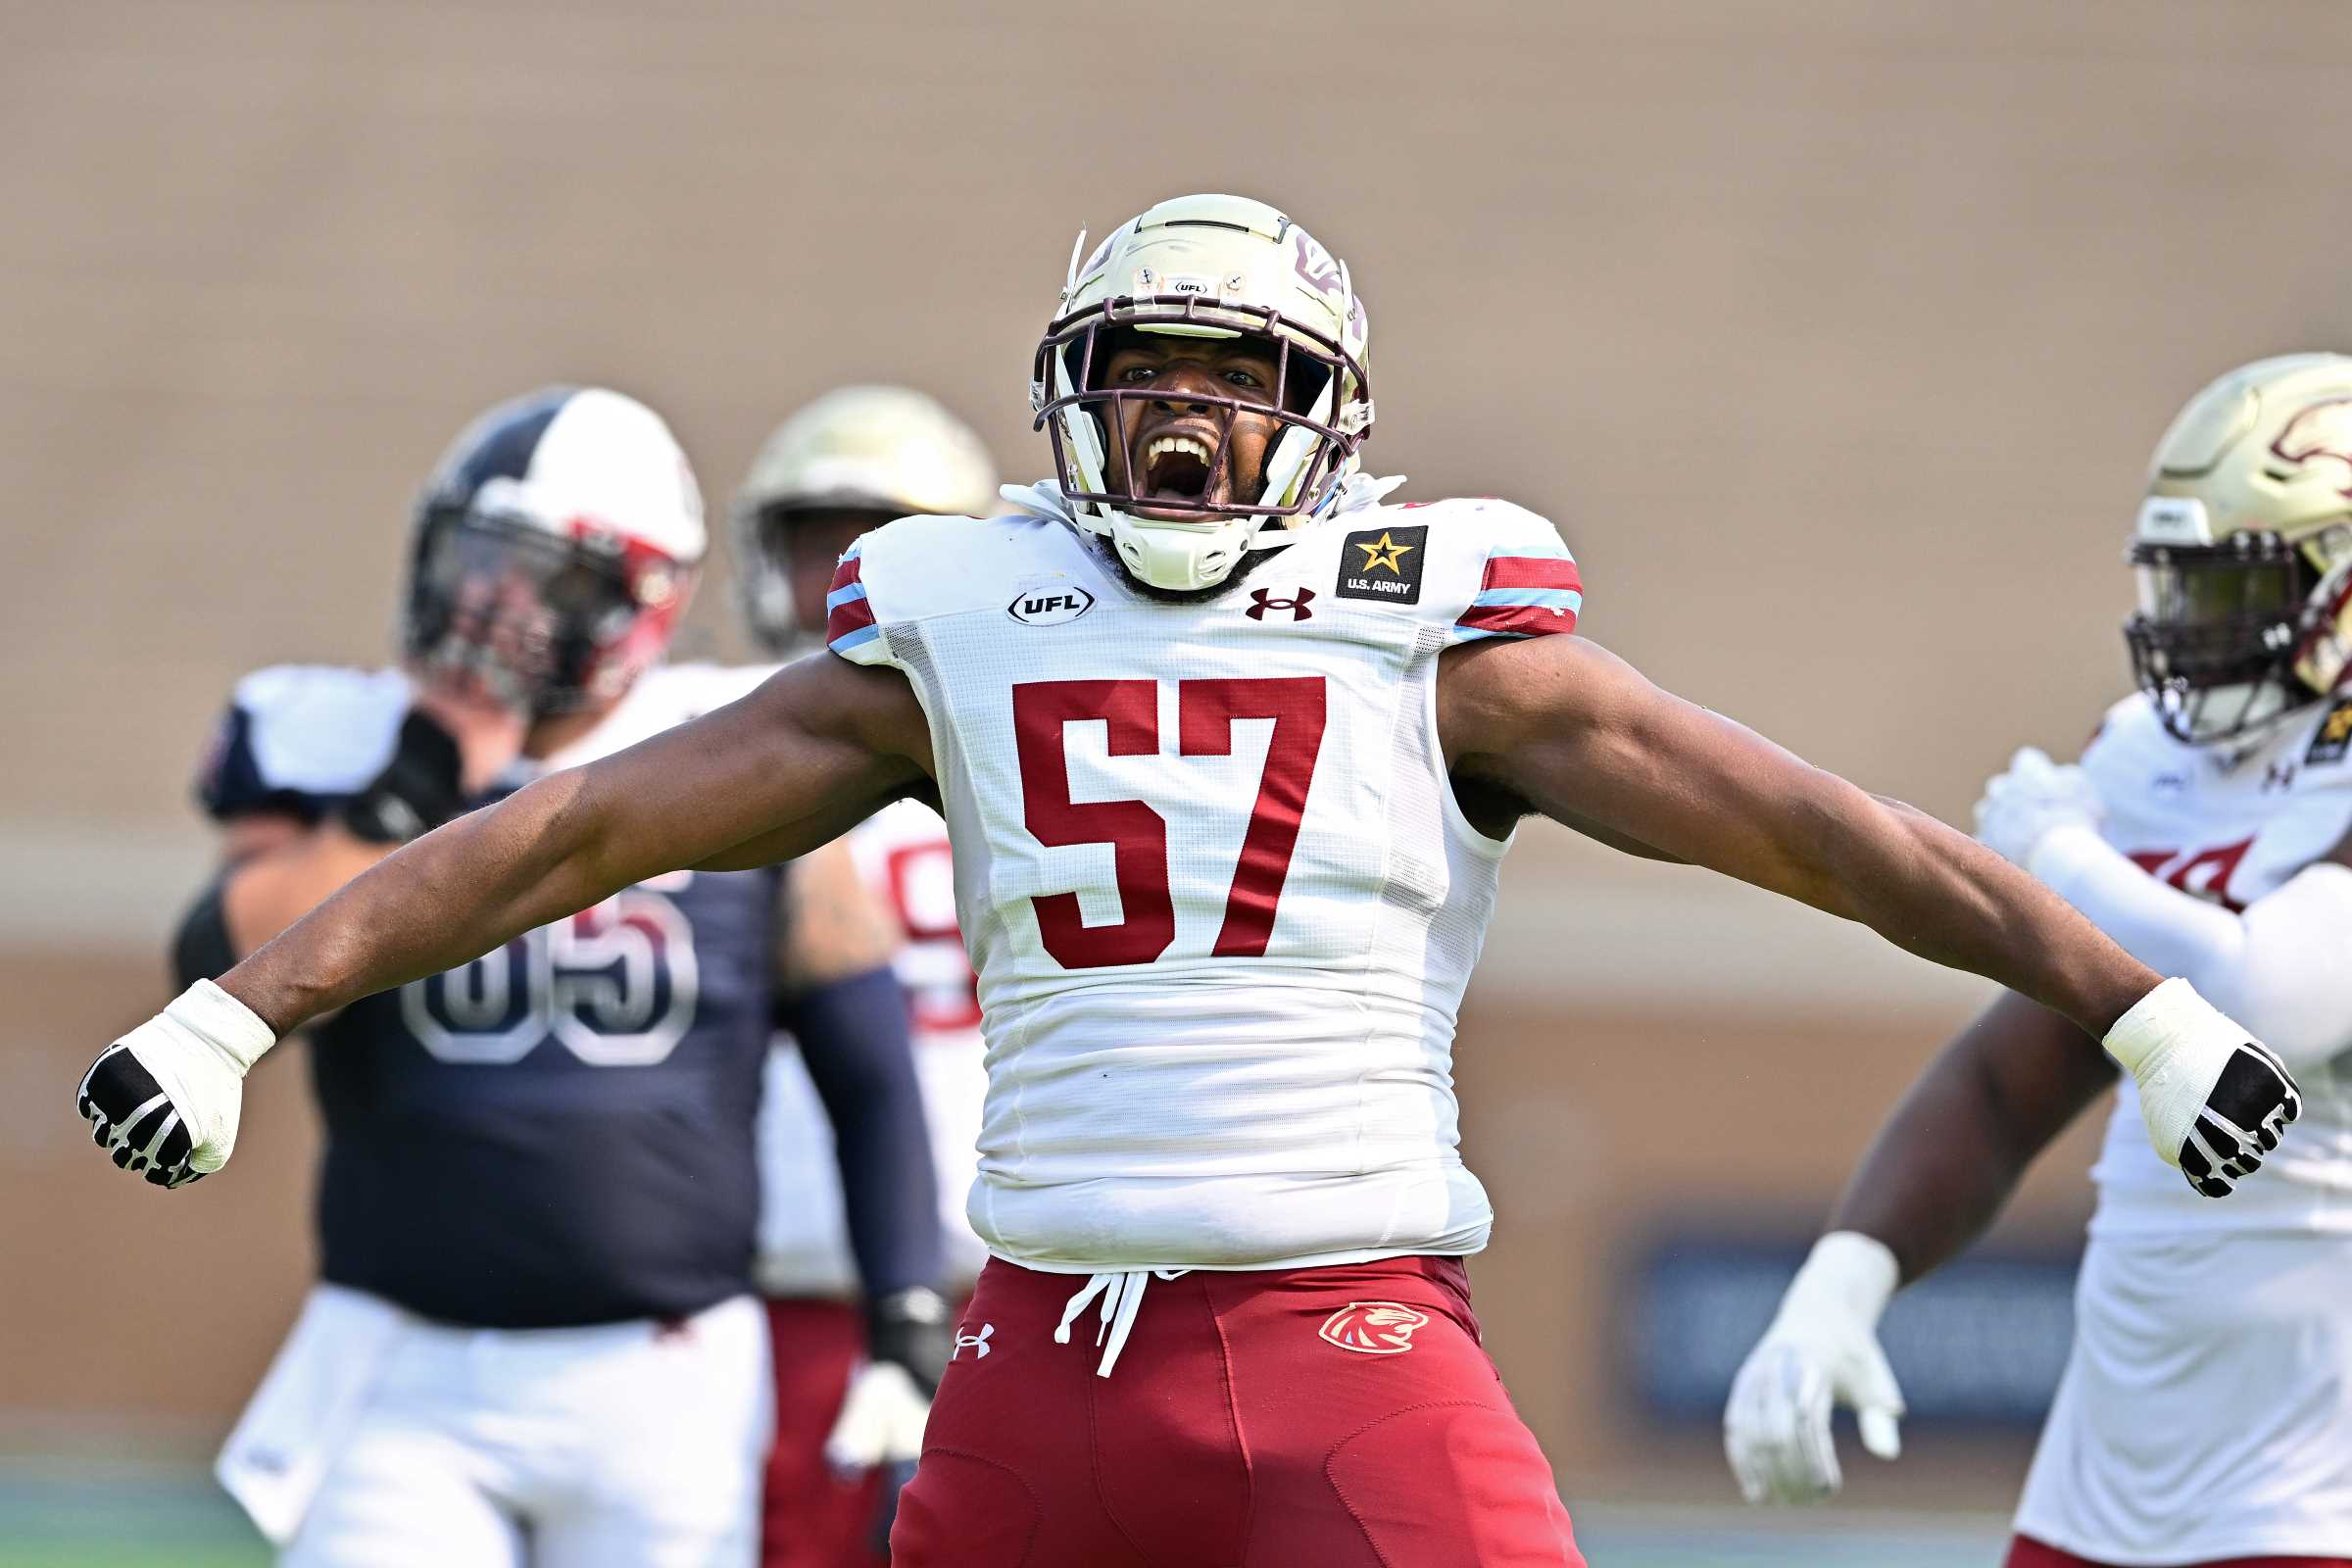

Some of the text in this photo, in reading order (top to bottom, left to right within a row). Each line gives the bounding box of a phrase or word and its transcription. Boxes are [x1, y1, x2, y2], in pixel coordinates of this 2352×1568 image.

[1348, 578, 1411, 594] U.S. ARMY
[1024, 595, 1080, 614] UFL
[1012, 676, 1326, 969] 57
